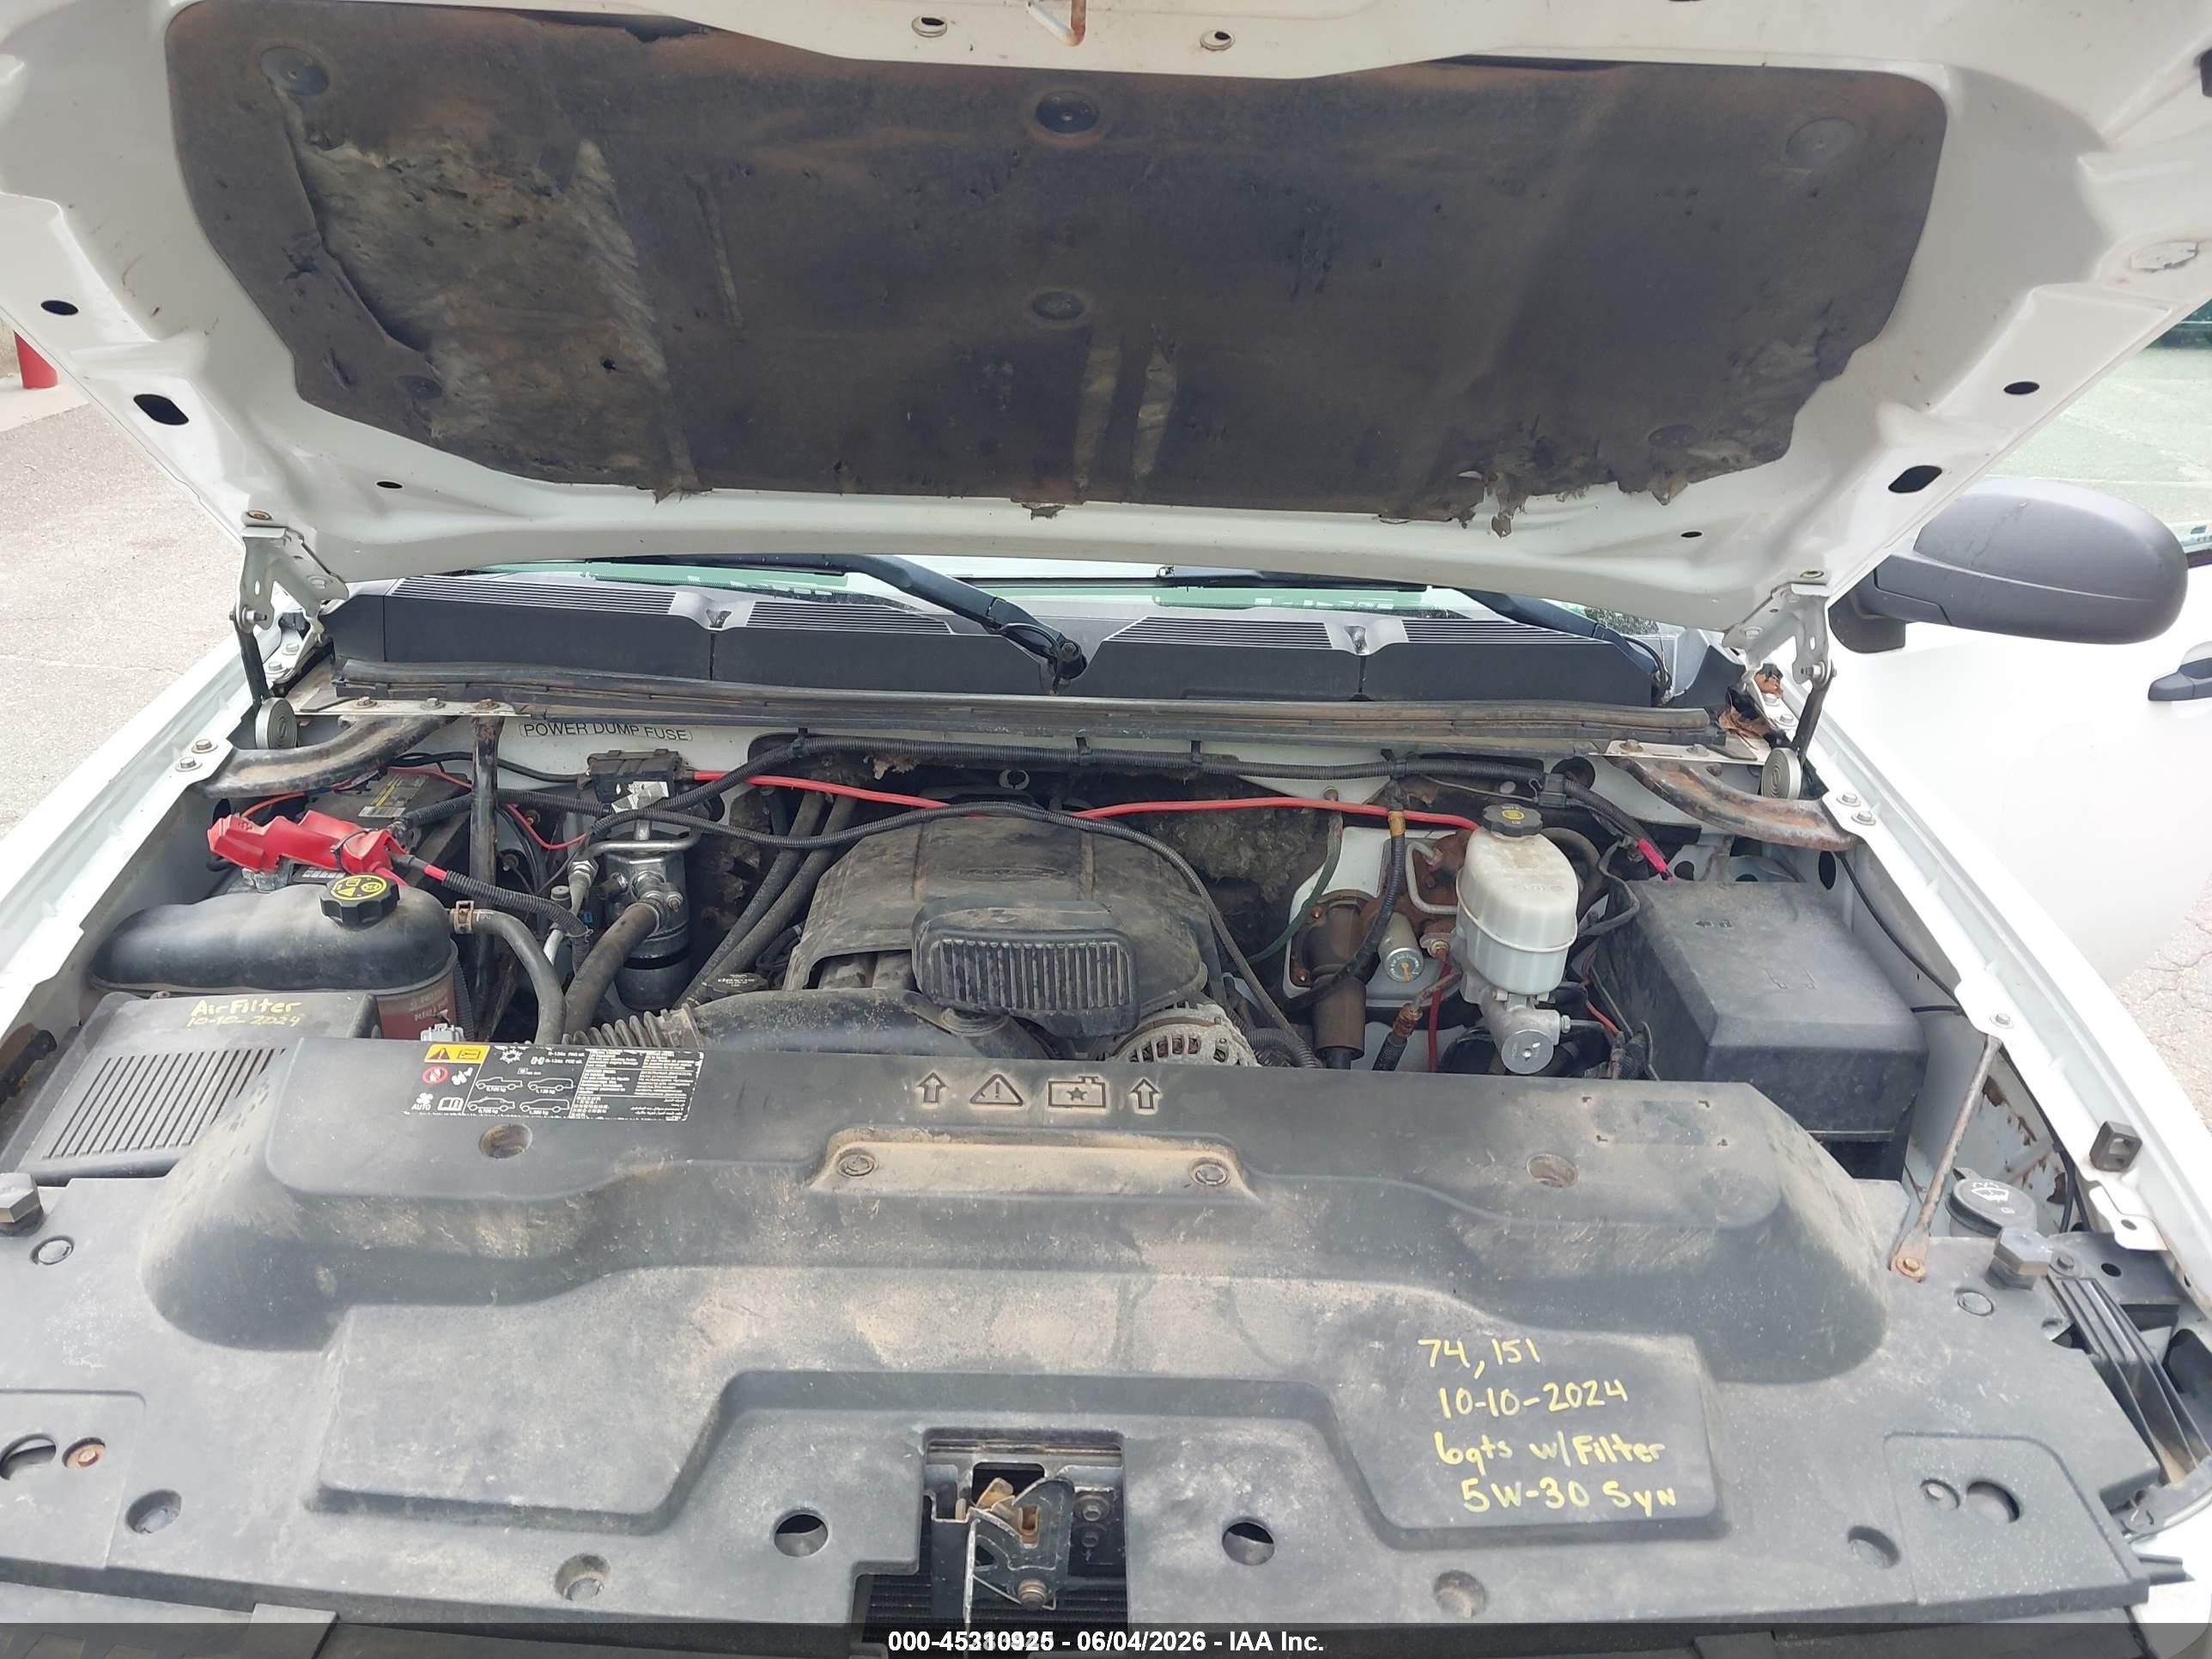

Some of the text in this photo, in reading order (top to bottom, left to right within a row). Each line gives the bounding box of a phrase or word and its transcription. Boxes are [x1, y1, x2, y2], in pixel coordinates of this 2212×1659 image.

[523, 722, 689, 741] POWER DUMP FUSE
[191, 998, 302, 1016] Air Filter
[1418, 1337, 1540, 1380] 74,151
[1439, 1379, 1629, 1419] 10-10-2024
